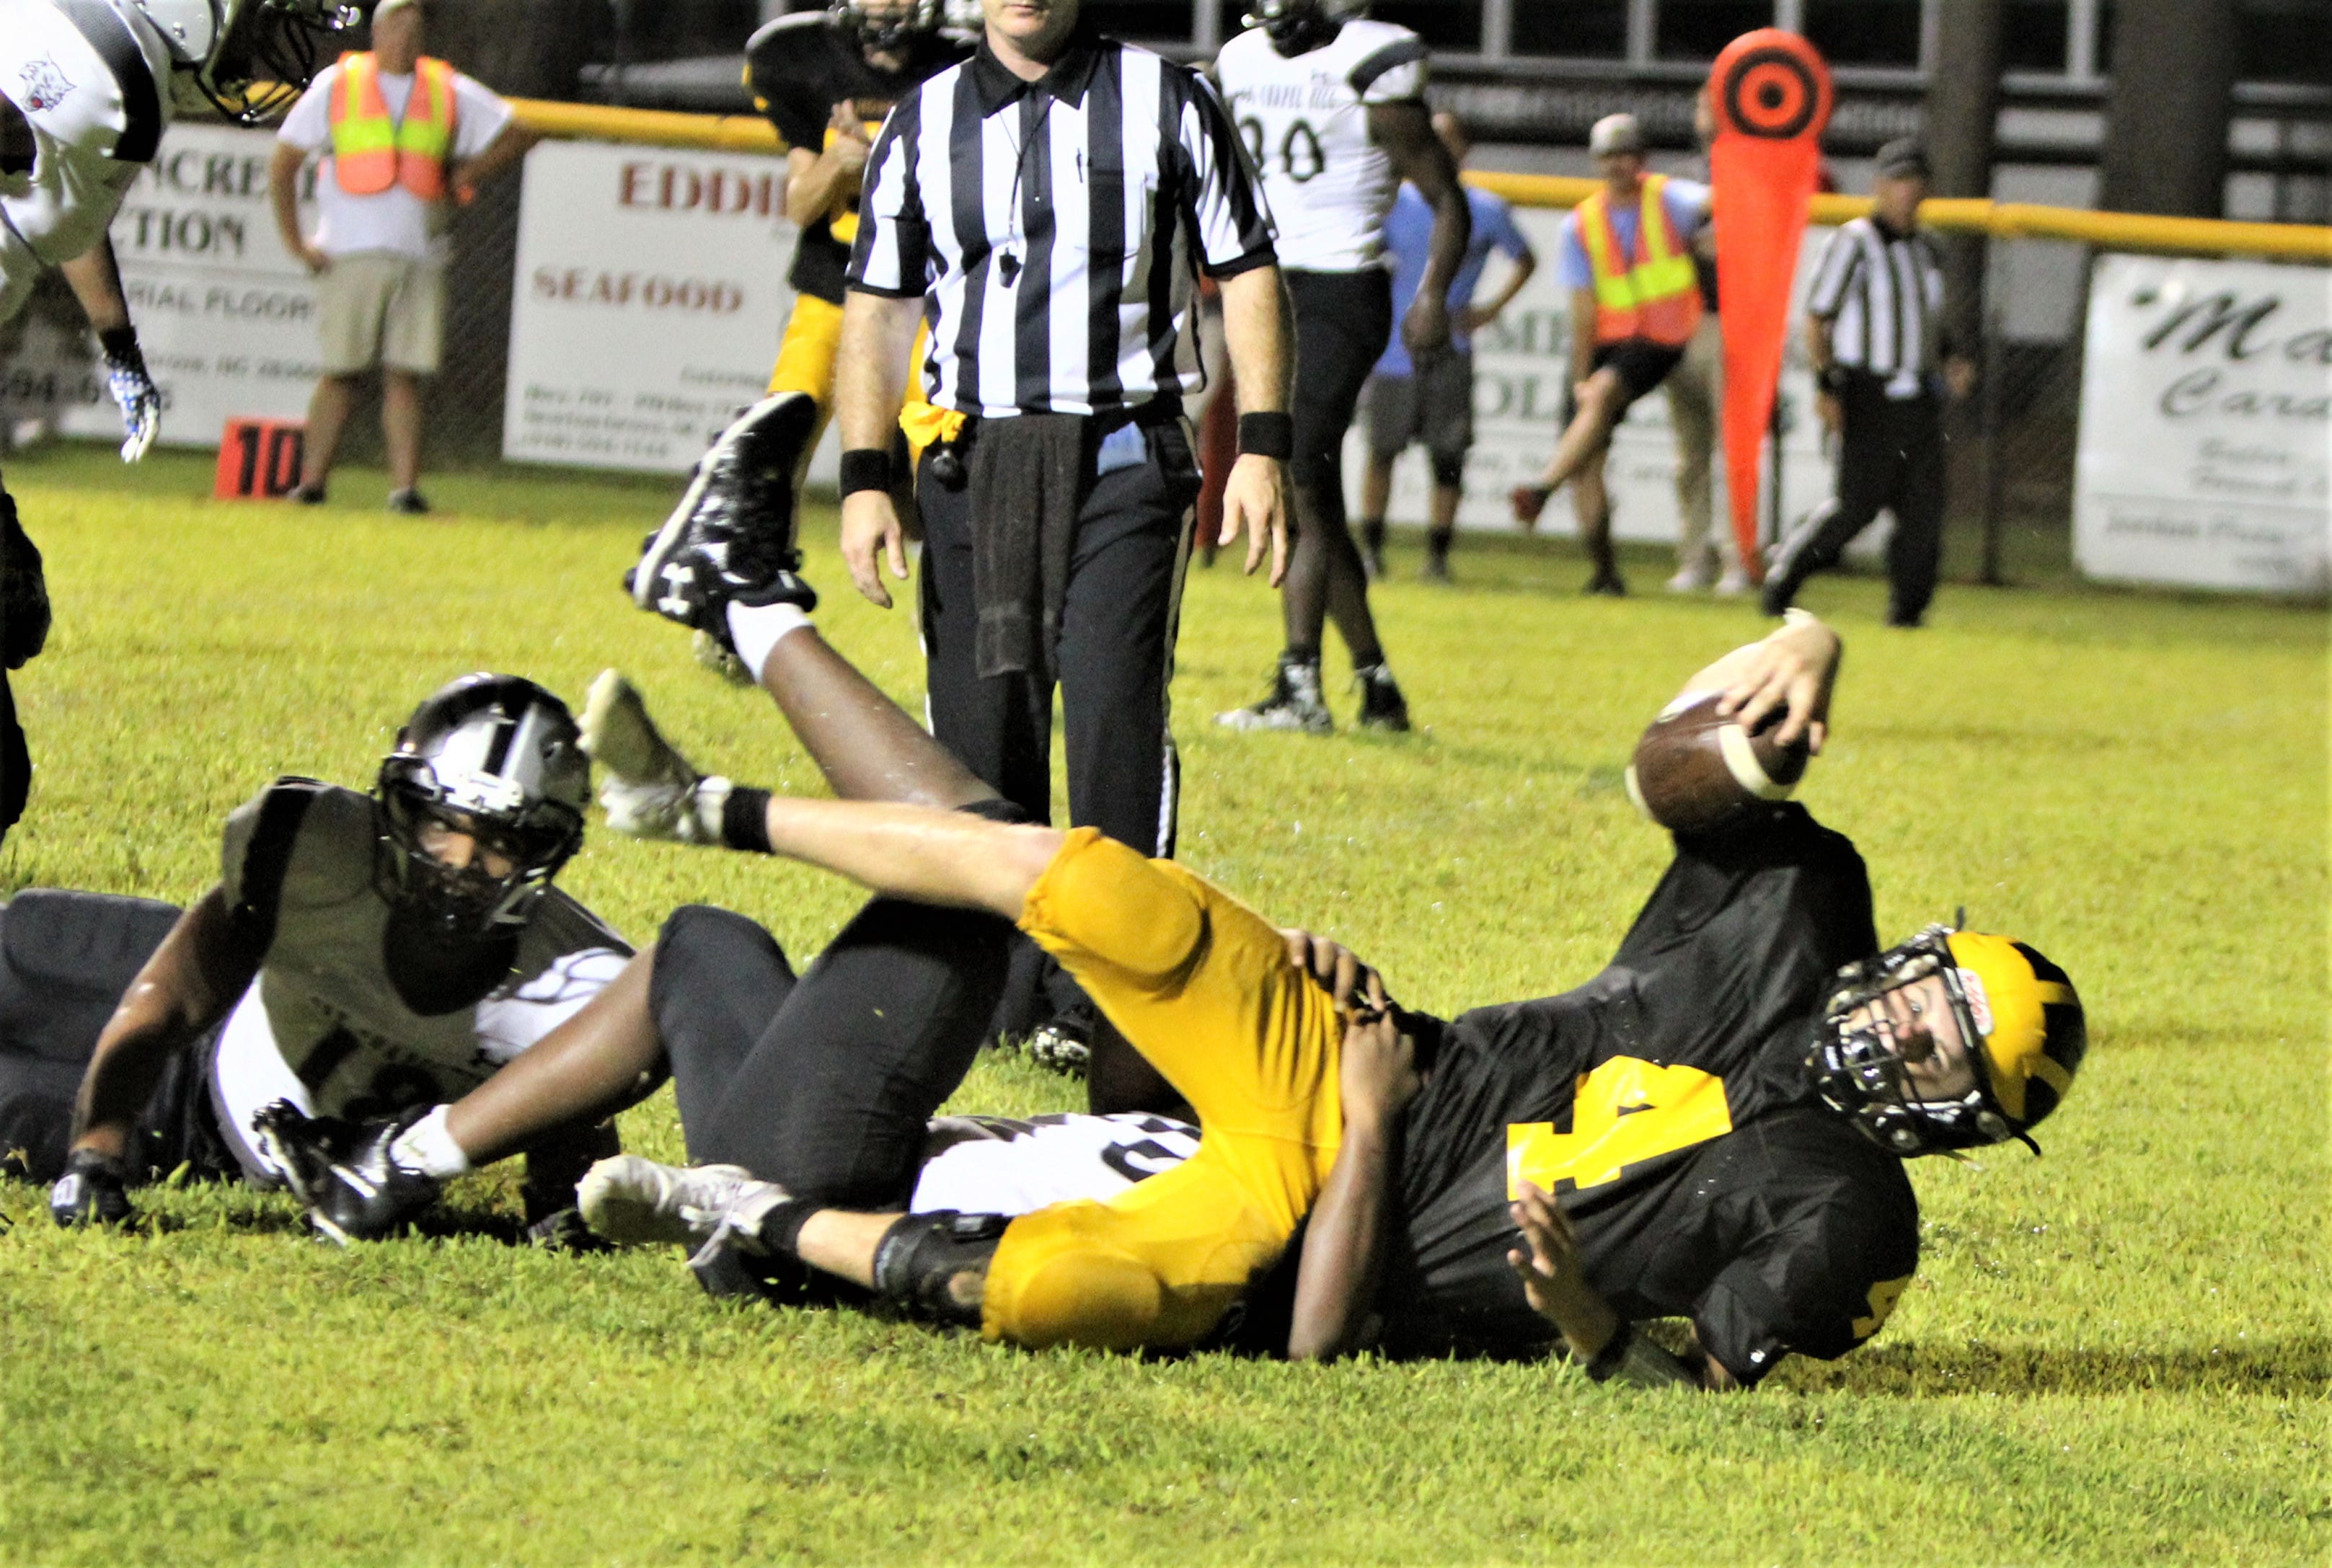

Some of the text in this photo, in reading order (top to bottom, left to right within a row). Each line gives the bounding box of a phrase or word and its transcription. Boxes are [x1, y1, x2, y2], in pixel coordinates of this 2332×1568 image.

[110, 203, 247, 257] TION
[532, 264, 744, 314] SEAFOOD
[238, 425, 304, 497] 10
[1506, 1055, 1733, 1202] 4
